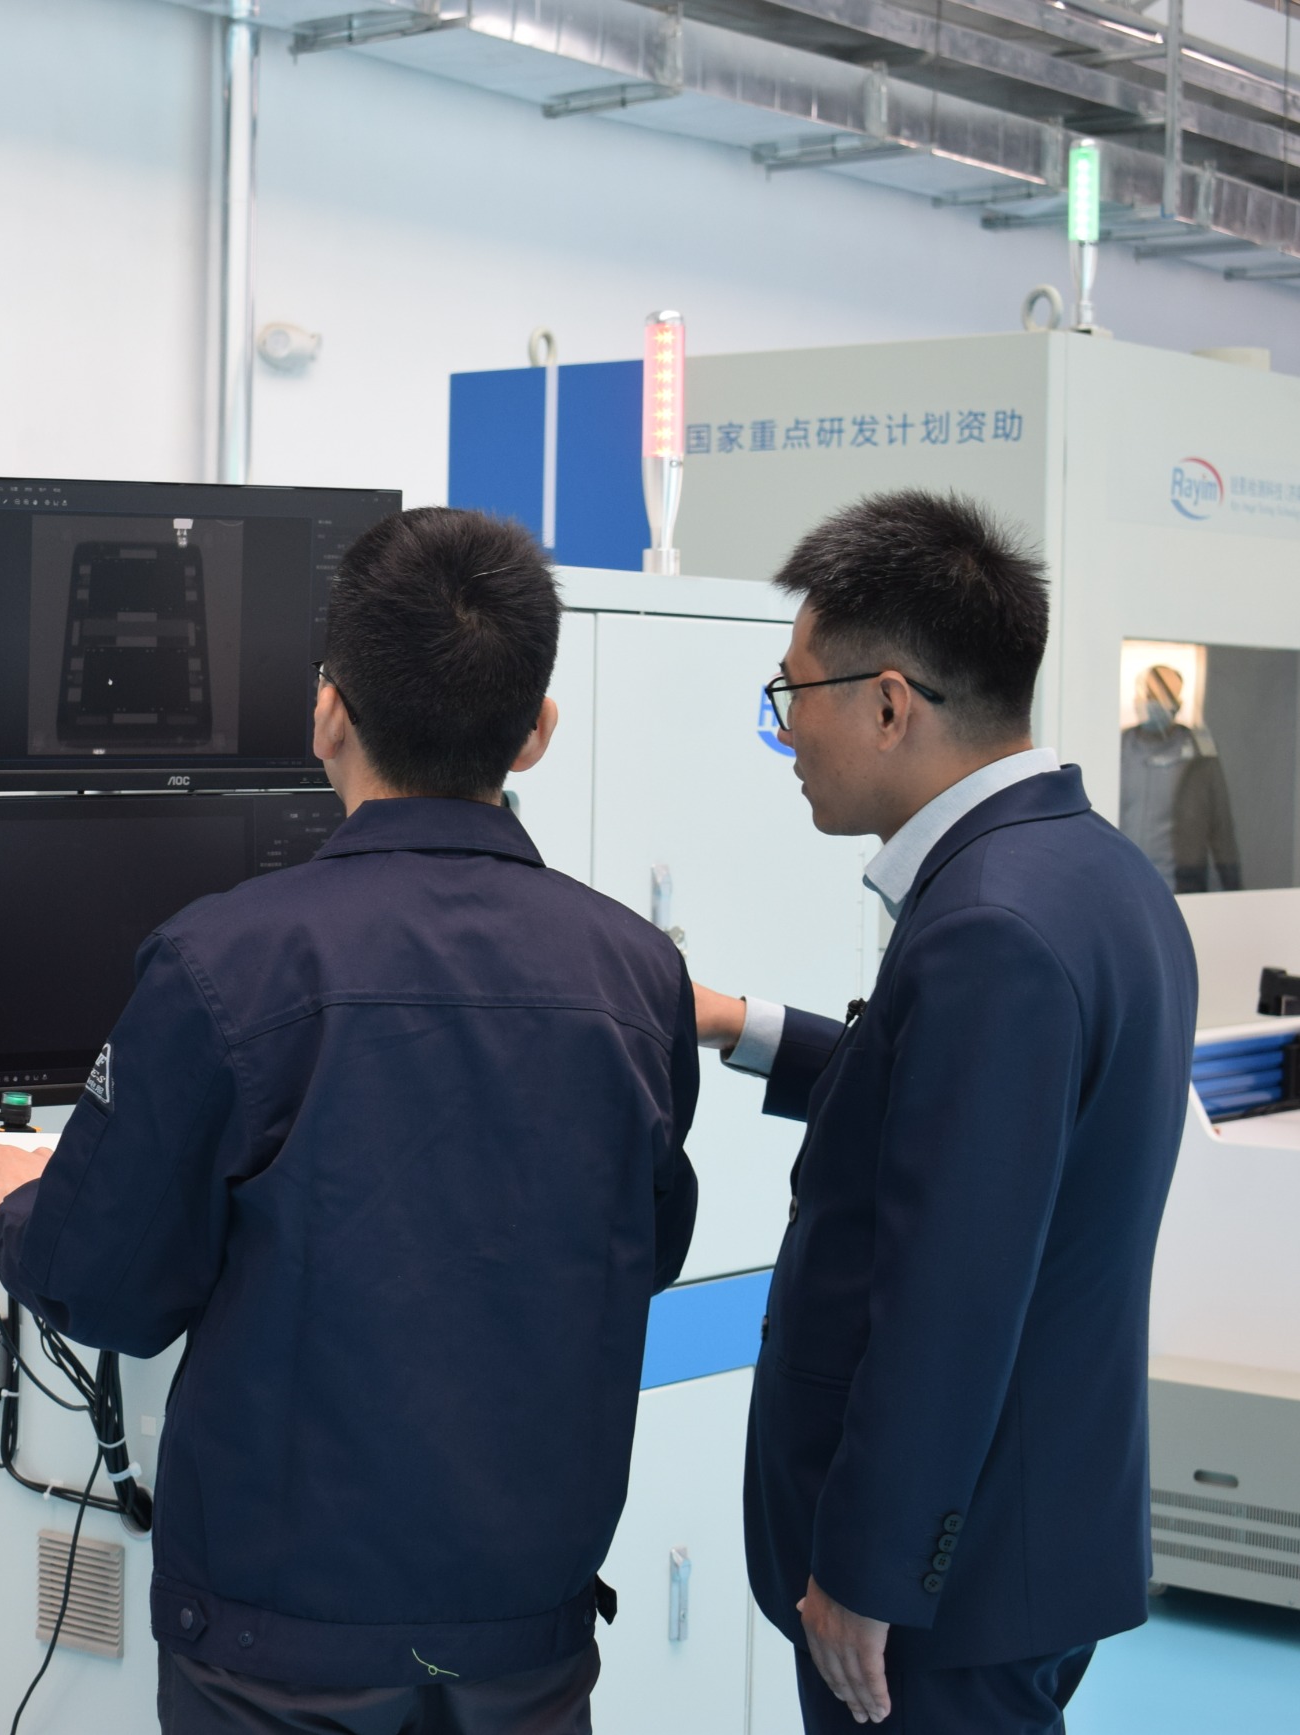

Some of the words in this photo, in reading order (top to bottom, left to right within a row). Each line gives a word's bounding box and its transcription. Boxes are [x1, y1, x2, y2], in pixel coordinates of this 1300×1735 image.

[686, 408, 1023, 455] 国家重点研发计划资助
[1171, 467, 1218, 507] Rayim
[167, 776, 190, 785] AOC
